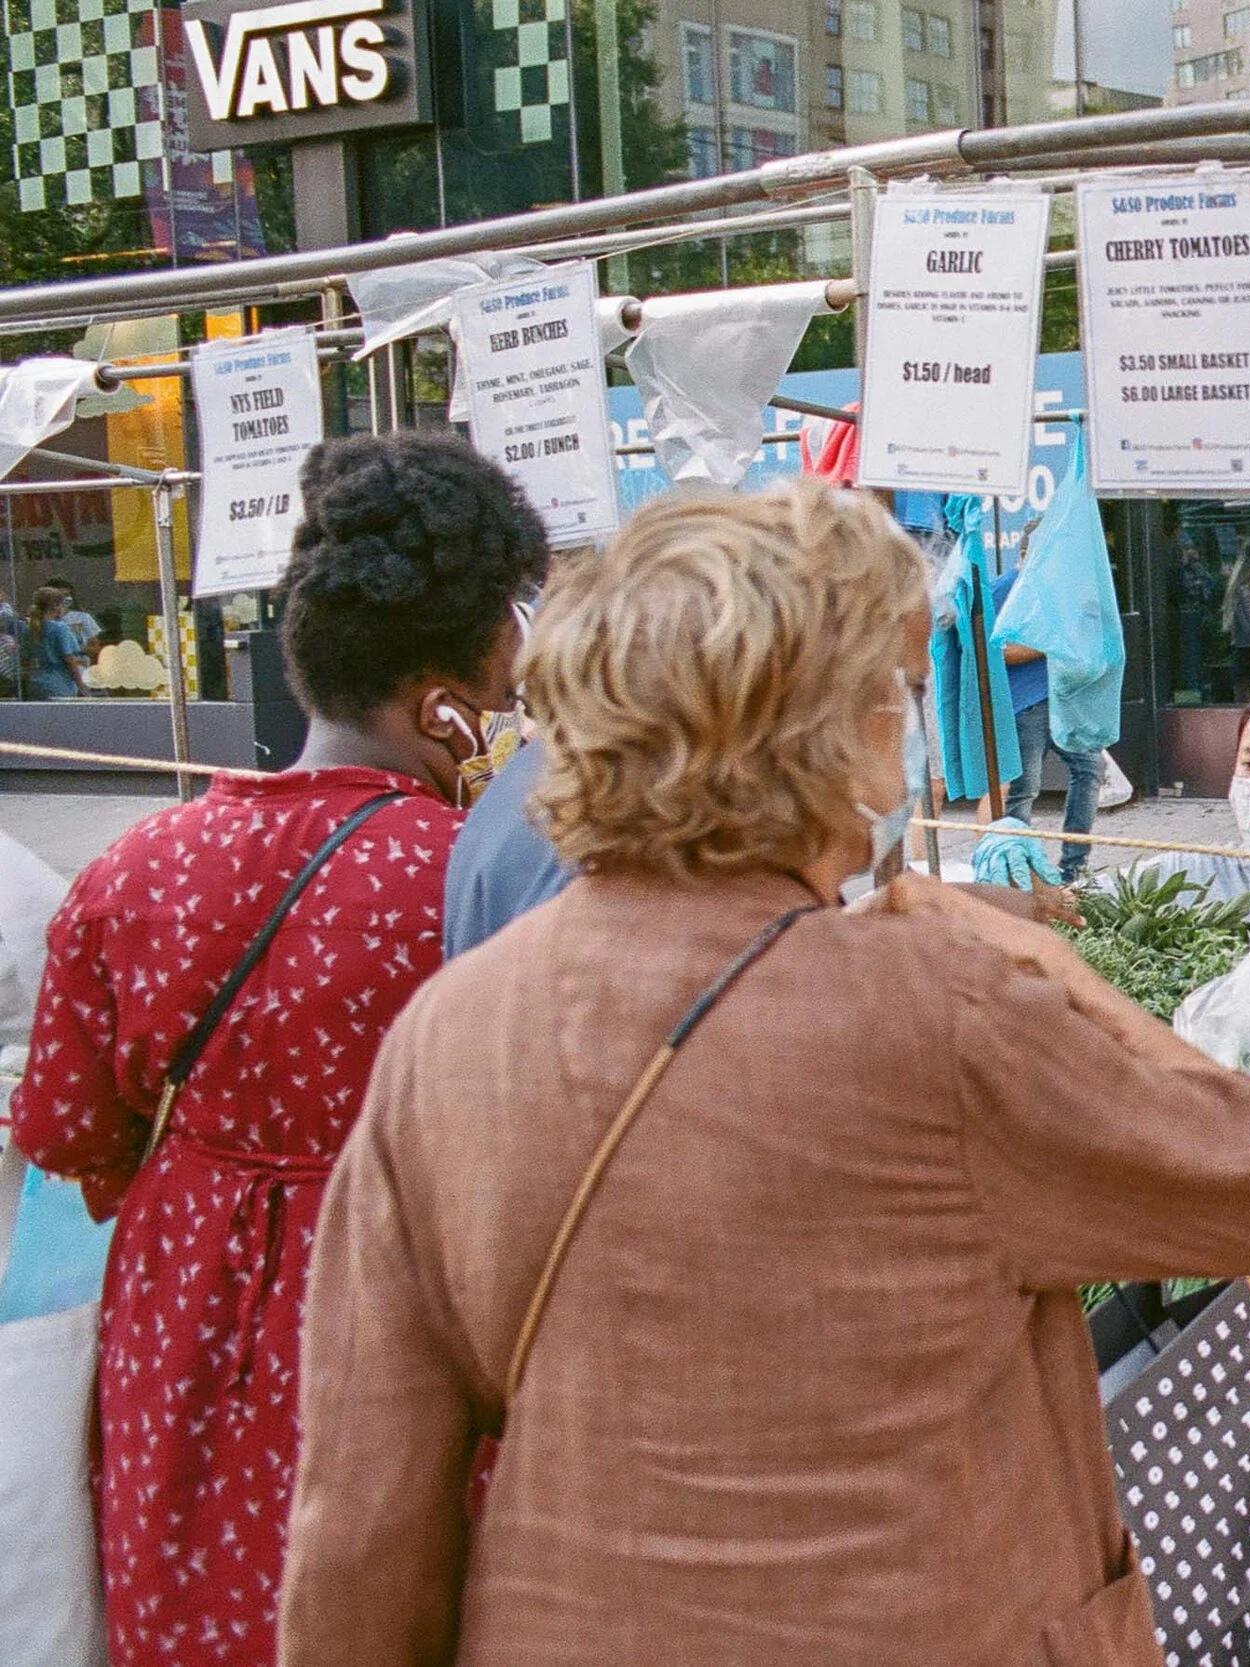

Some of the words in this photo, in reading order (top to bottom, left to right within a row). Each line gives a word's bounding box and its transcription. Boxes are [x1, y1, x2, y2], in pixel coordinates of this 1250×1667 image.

[184, 0, 388, 120] VANS
[1145, 194, 1194, 213] Produce
[1198, 192, 1237, 210] Farms
[932, 209, 979, 225] Produce
[981, 209, 1016, 225] Farms
[1105, 238, 1165, 262] CHERRY
[1169, 234, 1250, 260] TOMATOES
[926, 250, 984, 274] GARLIC
[505, 291, 541, 310] Produce
[489, 330, 520, 352] HERB
[521, 318, 568, 346] BUNCHES
[903, 361, 941, 382] $1.50
[954, 363, 991, 384] head
[1120, 354, 1156, 372] $3.50
[1158, 353, 1197, 371] SMALL
[1201, 352, 1250, 370] BASKET
[230, 393, 252, 415] NYS
[252, 387, 284, 410] FIELD
[1121, 385, 1158, 402] $6.00
[1161, 384, 1198, 401] LARGE
[1201, 384, 1250, 401] BASKET
[232, 414, 289, 442] TOMATOES
[504, 442, 535, 463] $2.00
[543, 432, 580, 456] BUNCH
[229, 497, 265, 522] $3.50
[275, 493, 290, 514] LB
